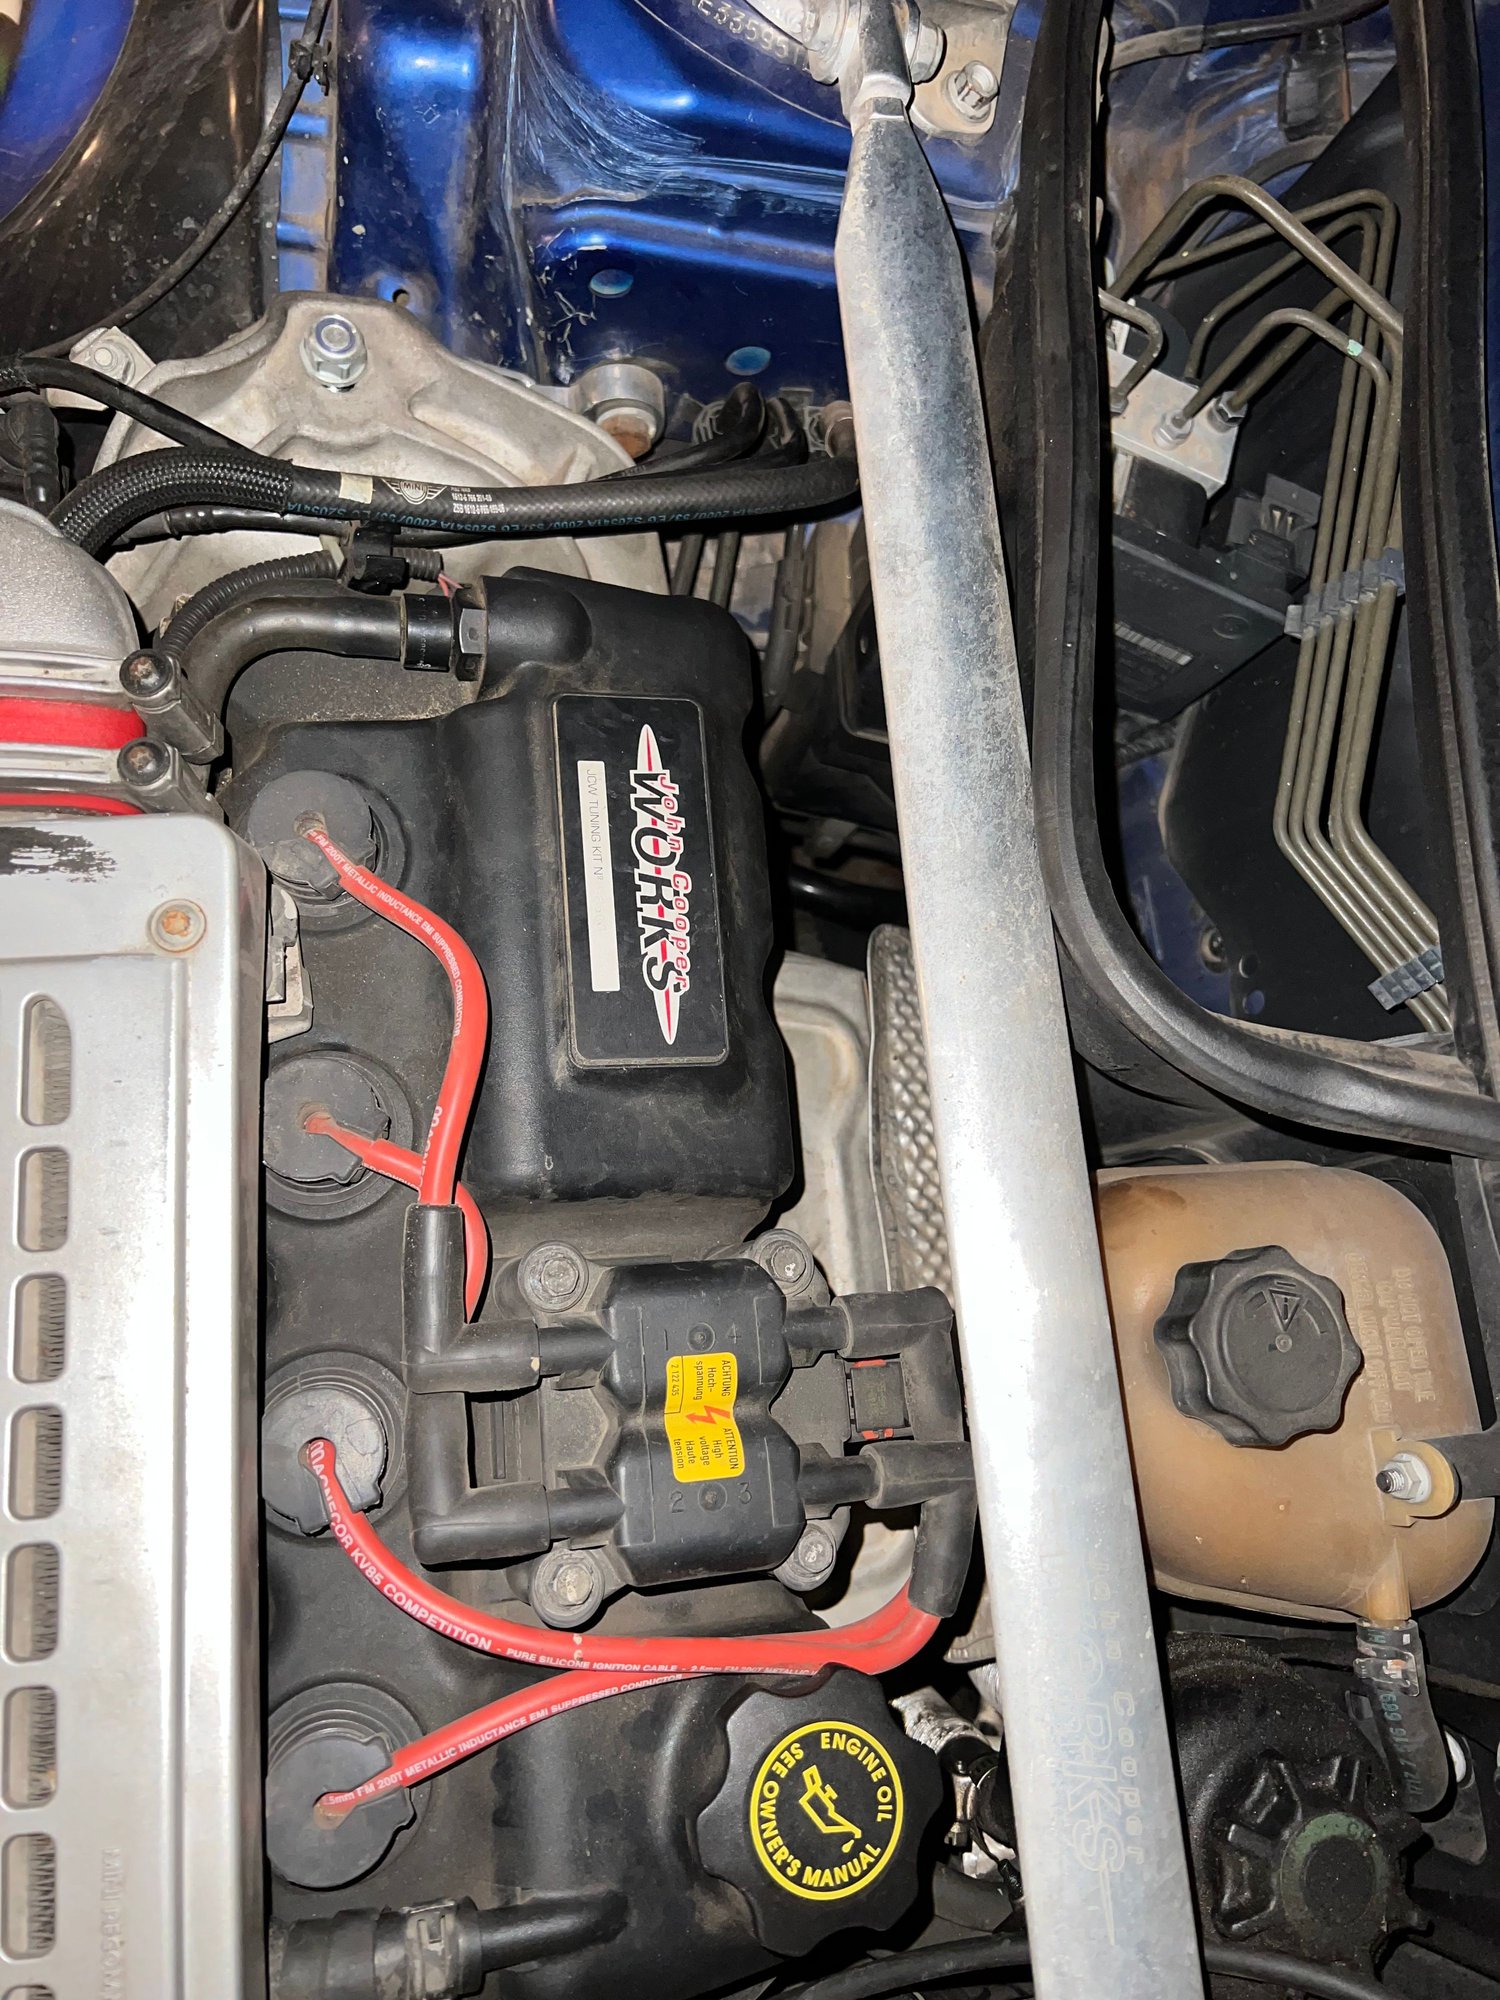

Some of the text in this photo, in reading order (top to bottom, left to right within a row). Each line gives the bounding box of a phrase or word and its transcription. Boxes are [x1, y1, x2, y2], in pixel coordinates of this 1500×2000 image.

[403, 482, 426, 492] MINI
[586, 769, 598, 795] JCW
[589, 800, 602, 842] TUNING
[592, 846, 603, 863] KIT
[632, 772, 682, 992] WORKS
[660, 775, 689, 989] John Cooper
[325, 845, 346, 864] 200T
[342, 863, 379, 894] METALLIC
[376, 889, 424, 926] INDUCTANCE
[420, 920, 436, 936] EMI
[431, 931, 461, 979] SUPPRESSED
[452, 979, 464, 1037] CONDUCTOR
[693, 1360, 704, 1400] spannung
[707, 1367, 717, 1392] Hoch-
[721, 1359, 732, 1397] ACHTUNG
[674, 1438, 684, 1469] tension
[685, 1440, 697, 1464] Haute
[699, 1436, 710, 1466] voltage
[712, 1440, 724, 1458] High
[722, 1427, 739, 1469] ATTENTION
[350, 1549, 385, 1586] KV85
[383, 1583, 493, 1650] COMPETITION
[506, 1648, 537, 1662] PURE
[538, 1655, 590, 1670] SILICONE
[592, 1662, 641, 1672] IGNITION
[642, 1664, 678, 1672] CABLE
[355, 1784, 376, 1797] FM
[376, 1771, 403, 1790] 200T
[404, 1747, 458, 1778] METALLIC
[458, 1715, 528, 1753] INDUCTANCE
[529, 1708, 549, 1722] EMI
[551, 1686, 619, 1713] SUPPRESSED
[620, 1673, 683, 1693] CONDUCTOR
[820, 1732, 893, 1822] ENGINE OIL
[1113, 1690, 1145, 1865] Cooper
[760, 1742, 882, 1888] SEE OWNER'S MANUAL
